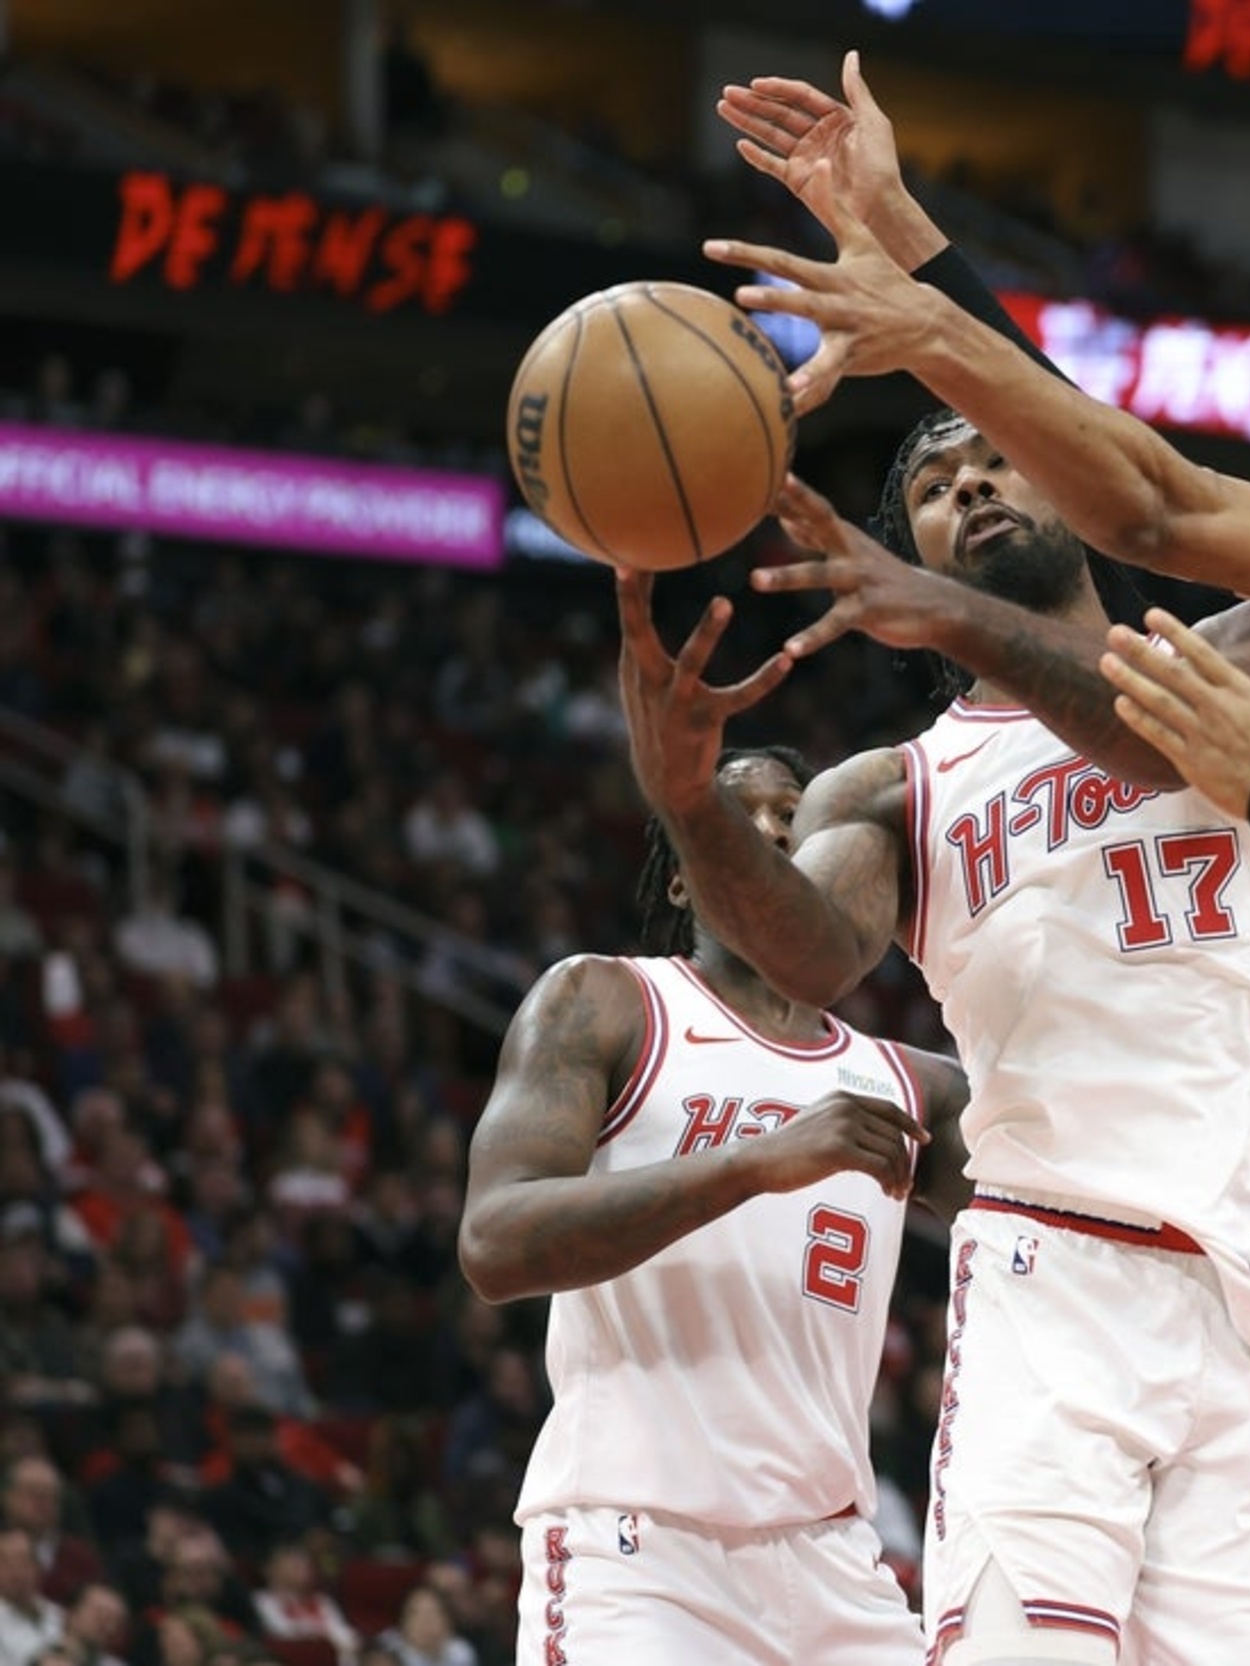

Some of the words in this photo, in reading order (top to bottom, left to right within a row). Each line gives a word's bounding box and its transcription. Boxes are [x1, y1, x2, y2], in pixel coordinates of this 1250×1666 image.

[0, 444, 142, 513] FFICIAL
[1101, 827, 1242, 953] 17
[802, 1202, 870, 1316] 2
